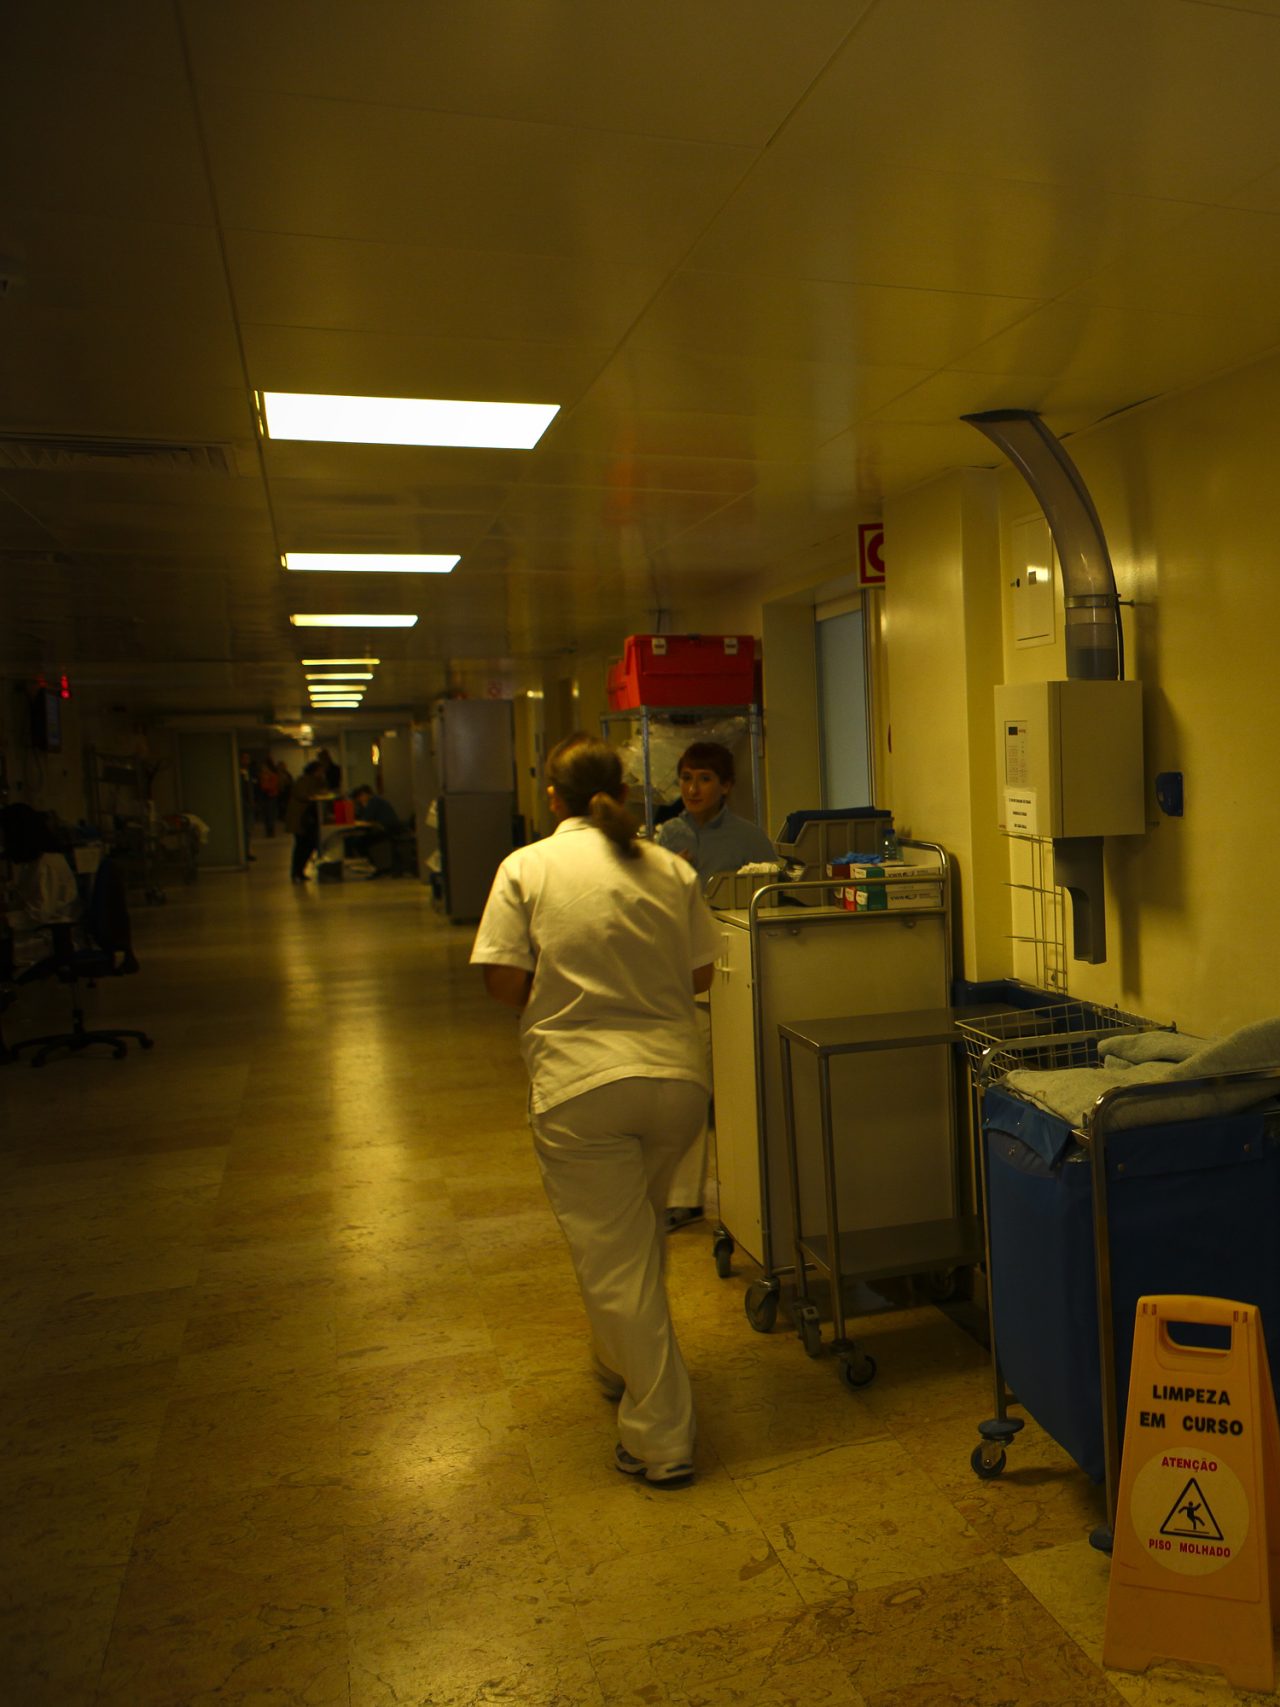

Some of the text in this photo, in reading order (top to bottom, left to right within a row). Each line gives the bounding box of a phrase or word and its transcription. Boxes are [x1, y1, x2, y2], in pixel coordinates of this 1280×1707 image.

[1152, 1384, 1231, 1406] LIMPEZA
[1139, 1411, 1244, 1436] EM CURSO
[1161, 1456, 1218, 1473] ATENÇÃO
[1148, 1538, 1232, 1559] PISO MOLHADO
